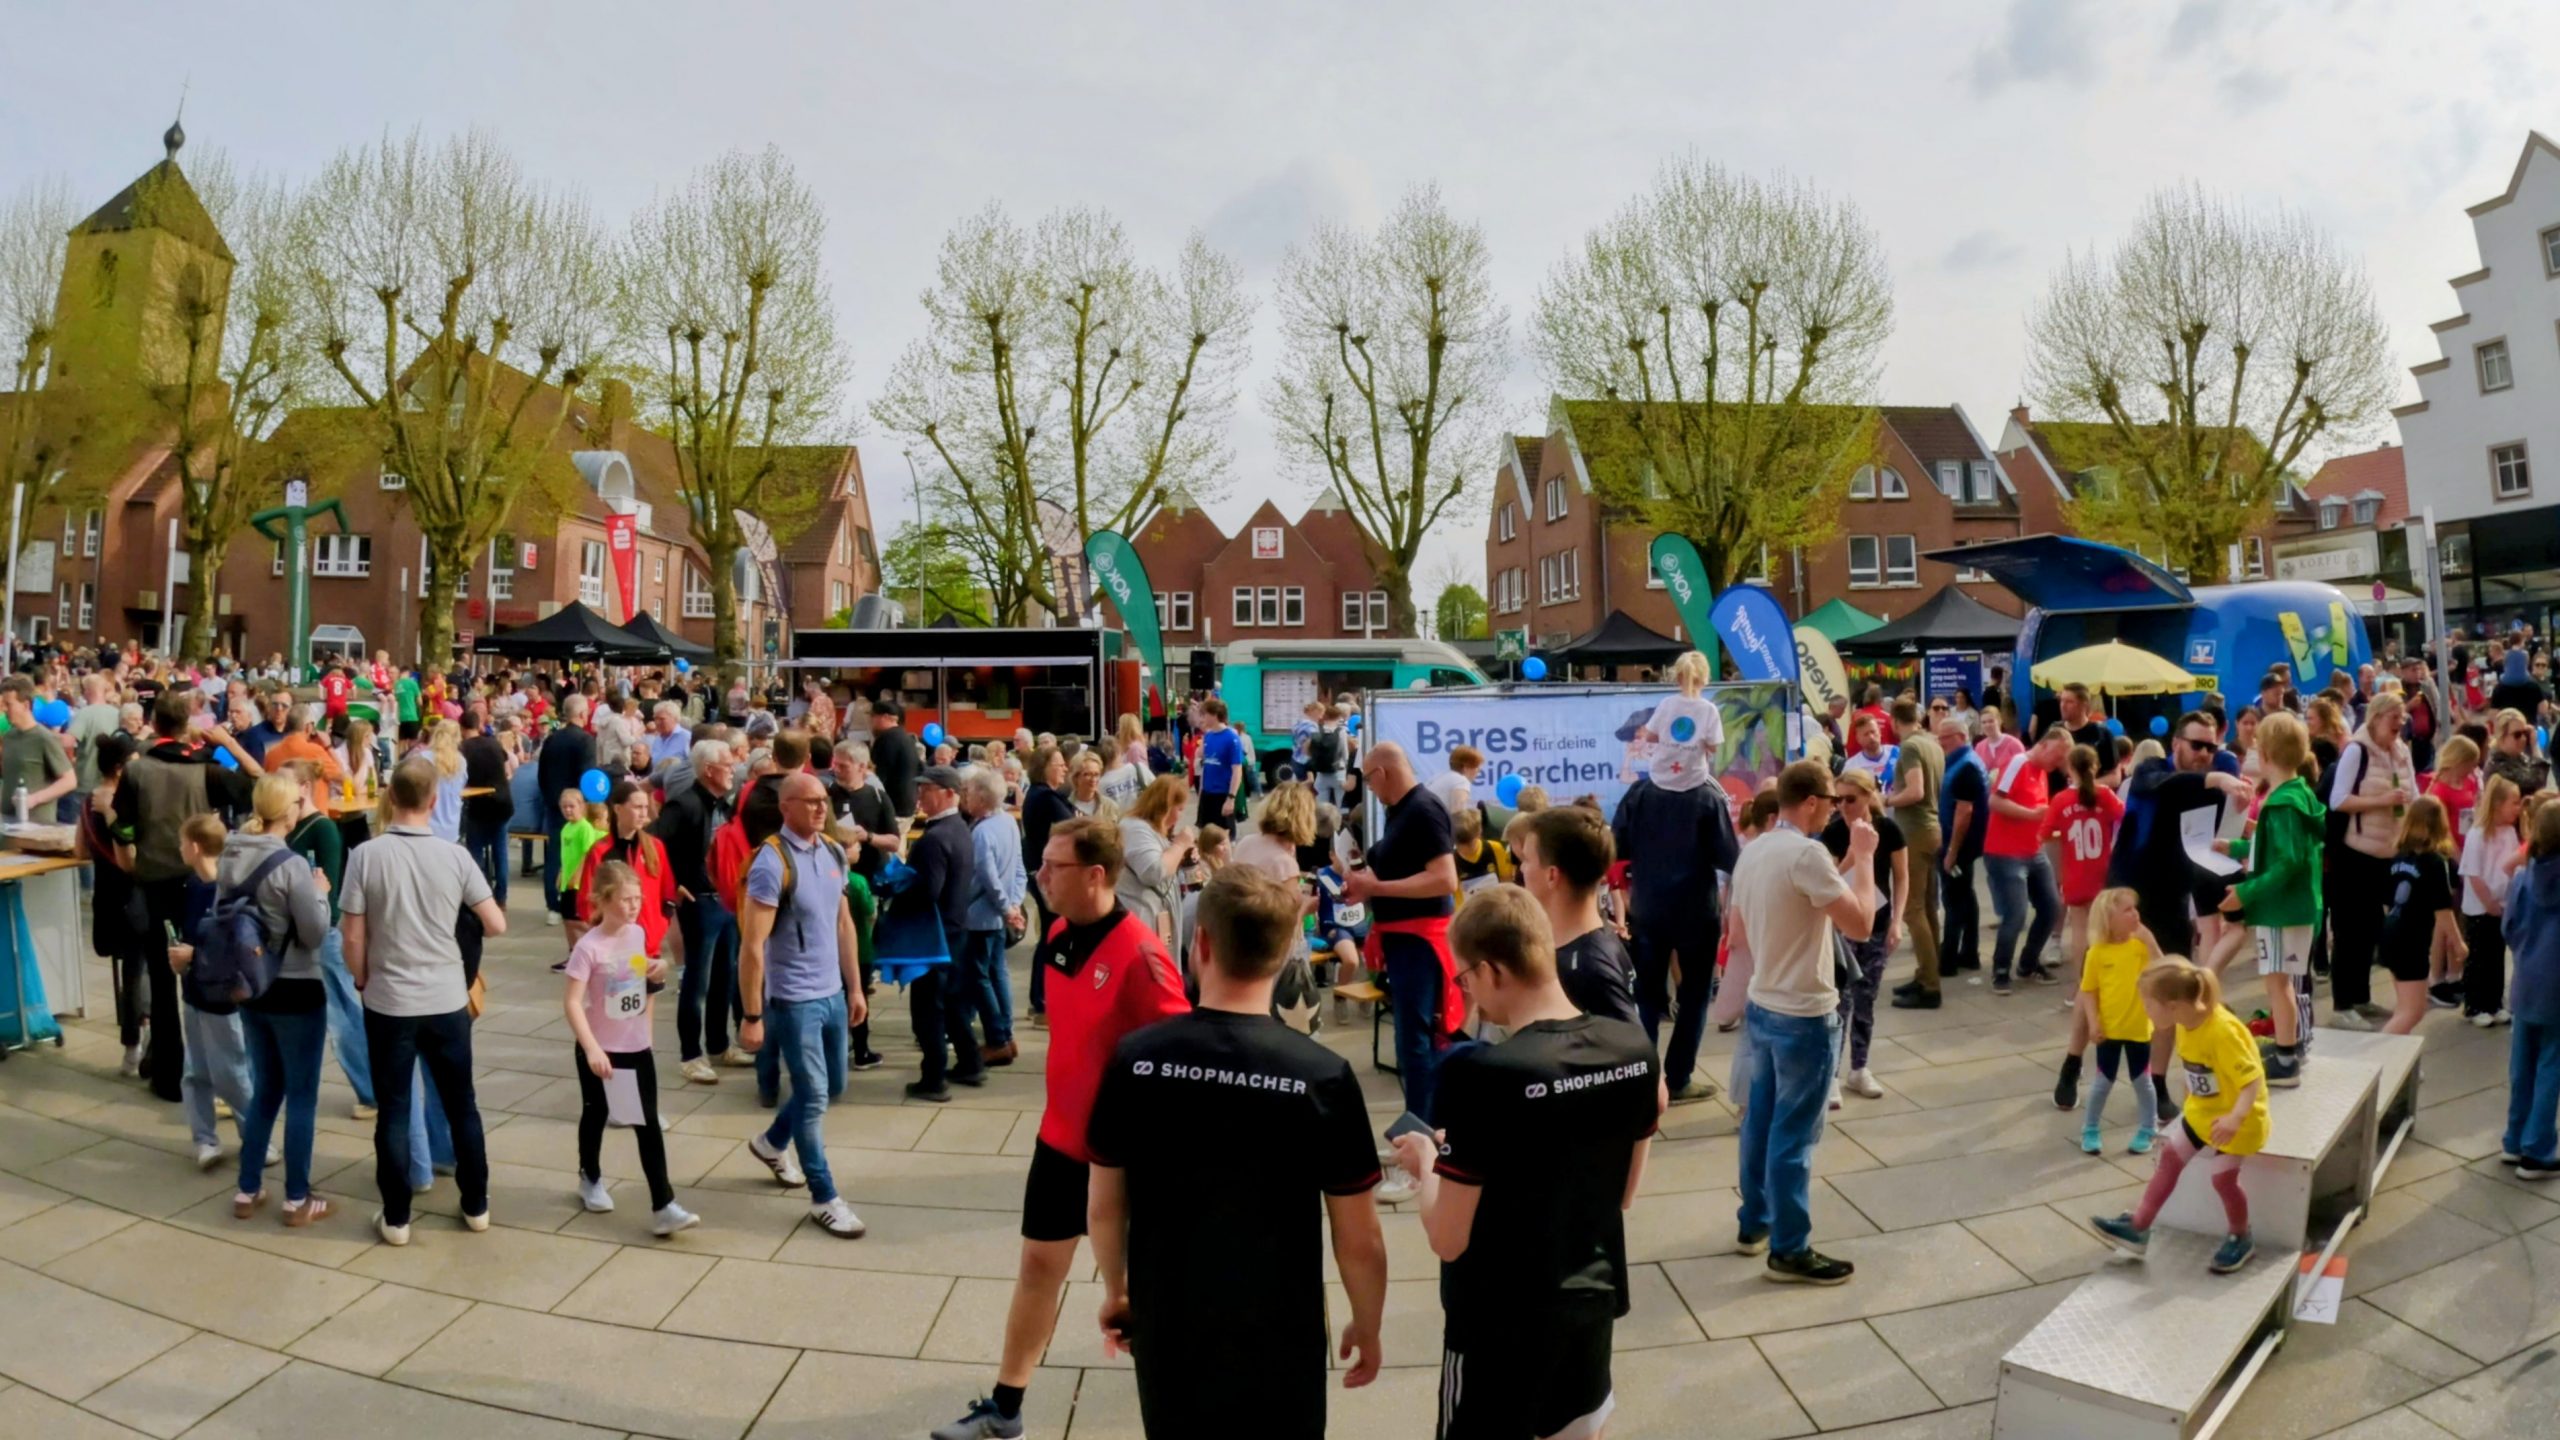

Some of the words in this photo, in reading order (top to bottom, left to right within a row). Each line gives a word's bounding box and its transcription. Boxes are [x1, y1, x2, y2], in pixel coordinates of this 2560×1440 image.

[2300, 554, 2342, 569] KORFU
[1416, 721, 1527, 754] Bares
[1532, 735, 1554, 751] für
[1556, 736, 1597, 751] deine
[1473, 757, 1622, 786] eißerchen.
[2068, 818, 2103, 860] 10
[621, 993, 641, 1012] 86
[1161, 1063, 1307, 1094] SHOPMACHER
[1553, 1061, 1648, 1093] SHOPMACHER
